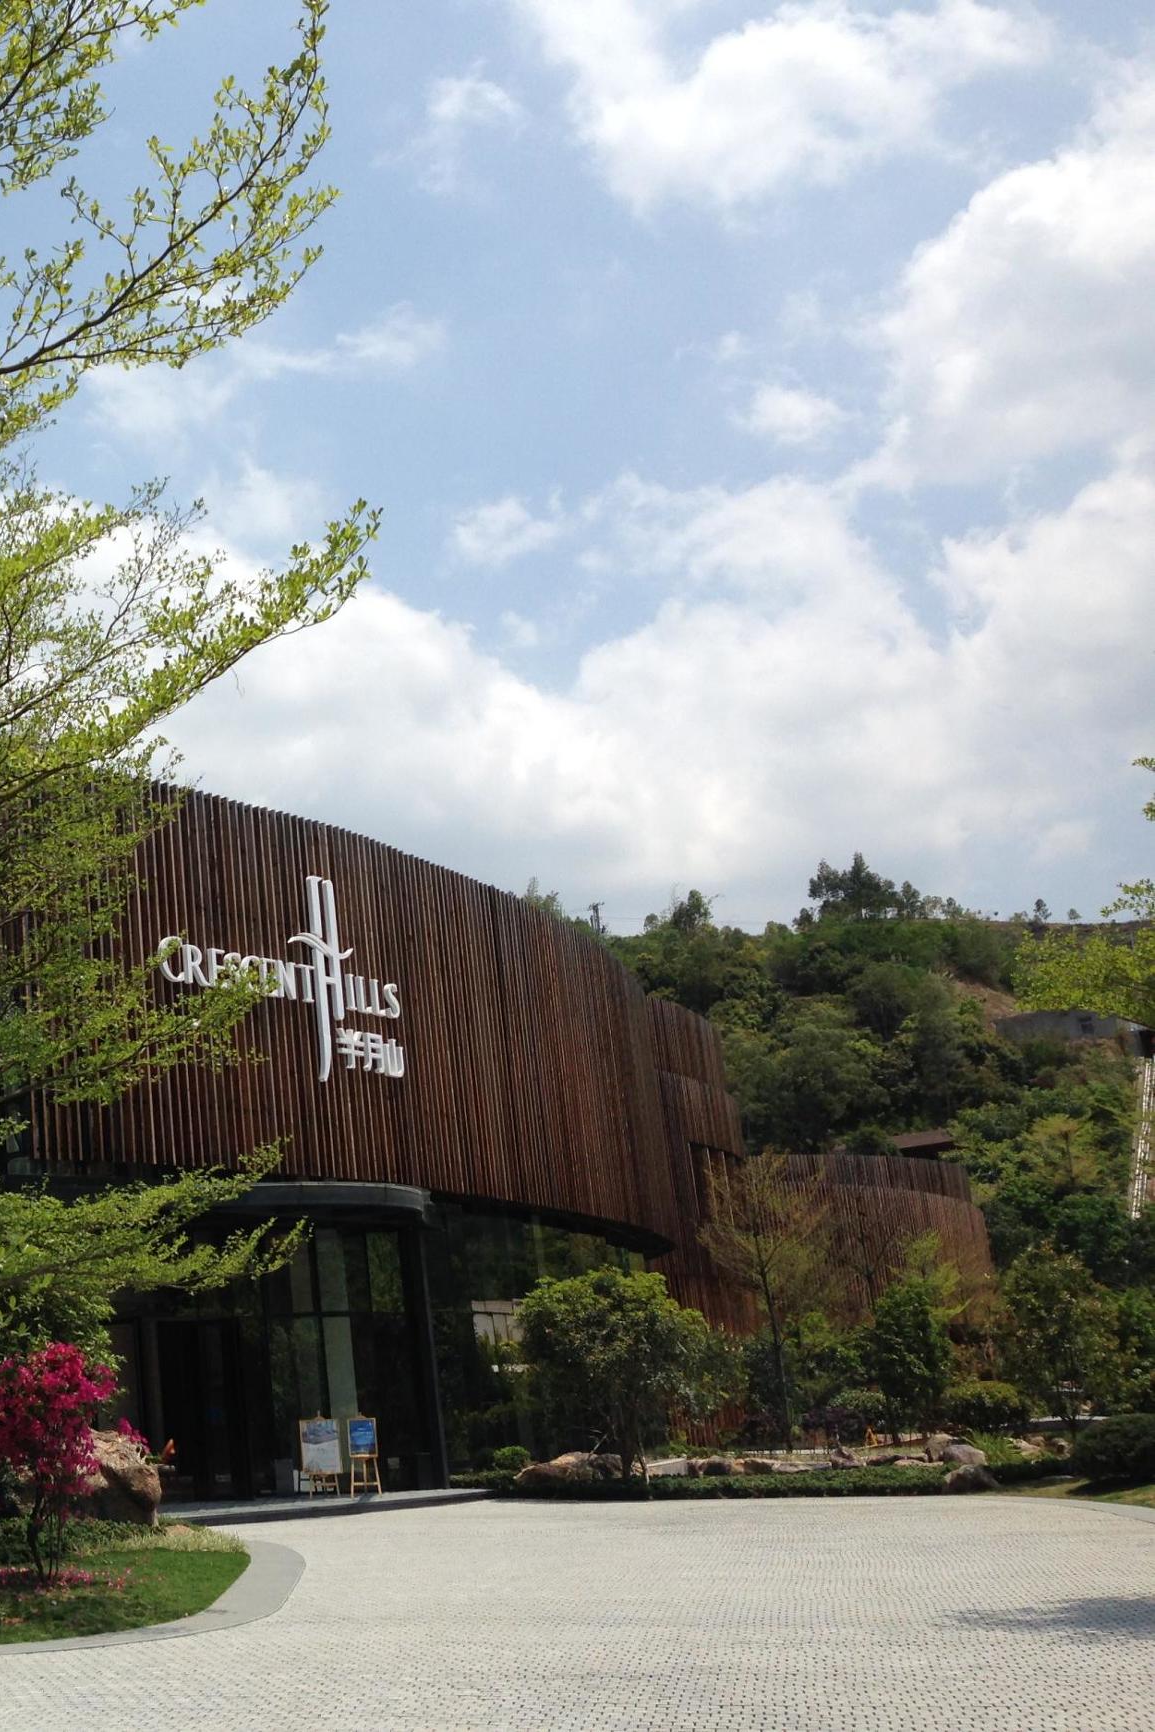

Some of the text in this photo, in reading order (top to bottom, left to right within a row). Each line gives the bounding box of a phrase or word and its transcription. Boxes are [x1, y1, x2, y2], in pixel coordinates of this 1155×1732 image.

[287, 875, 400, 1082] HILLS
[335, 1027, 405, 1078] 半月山
